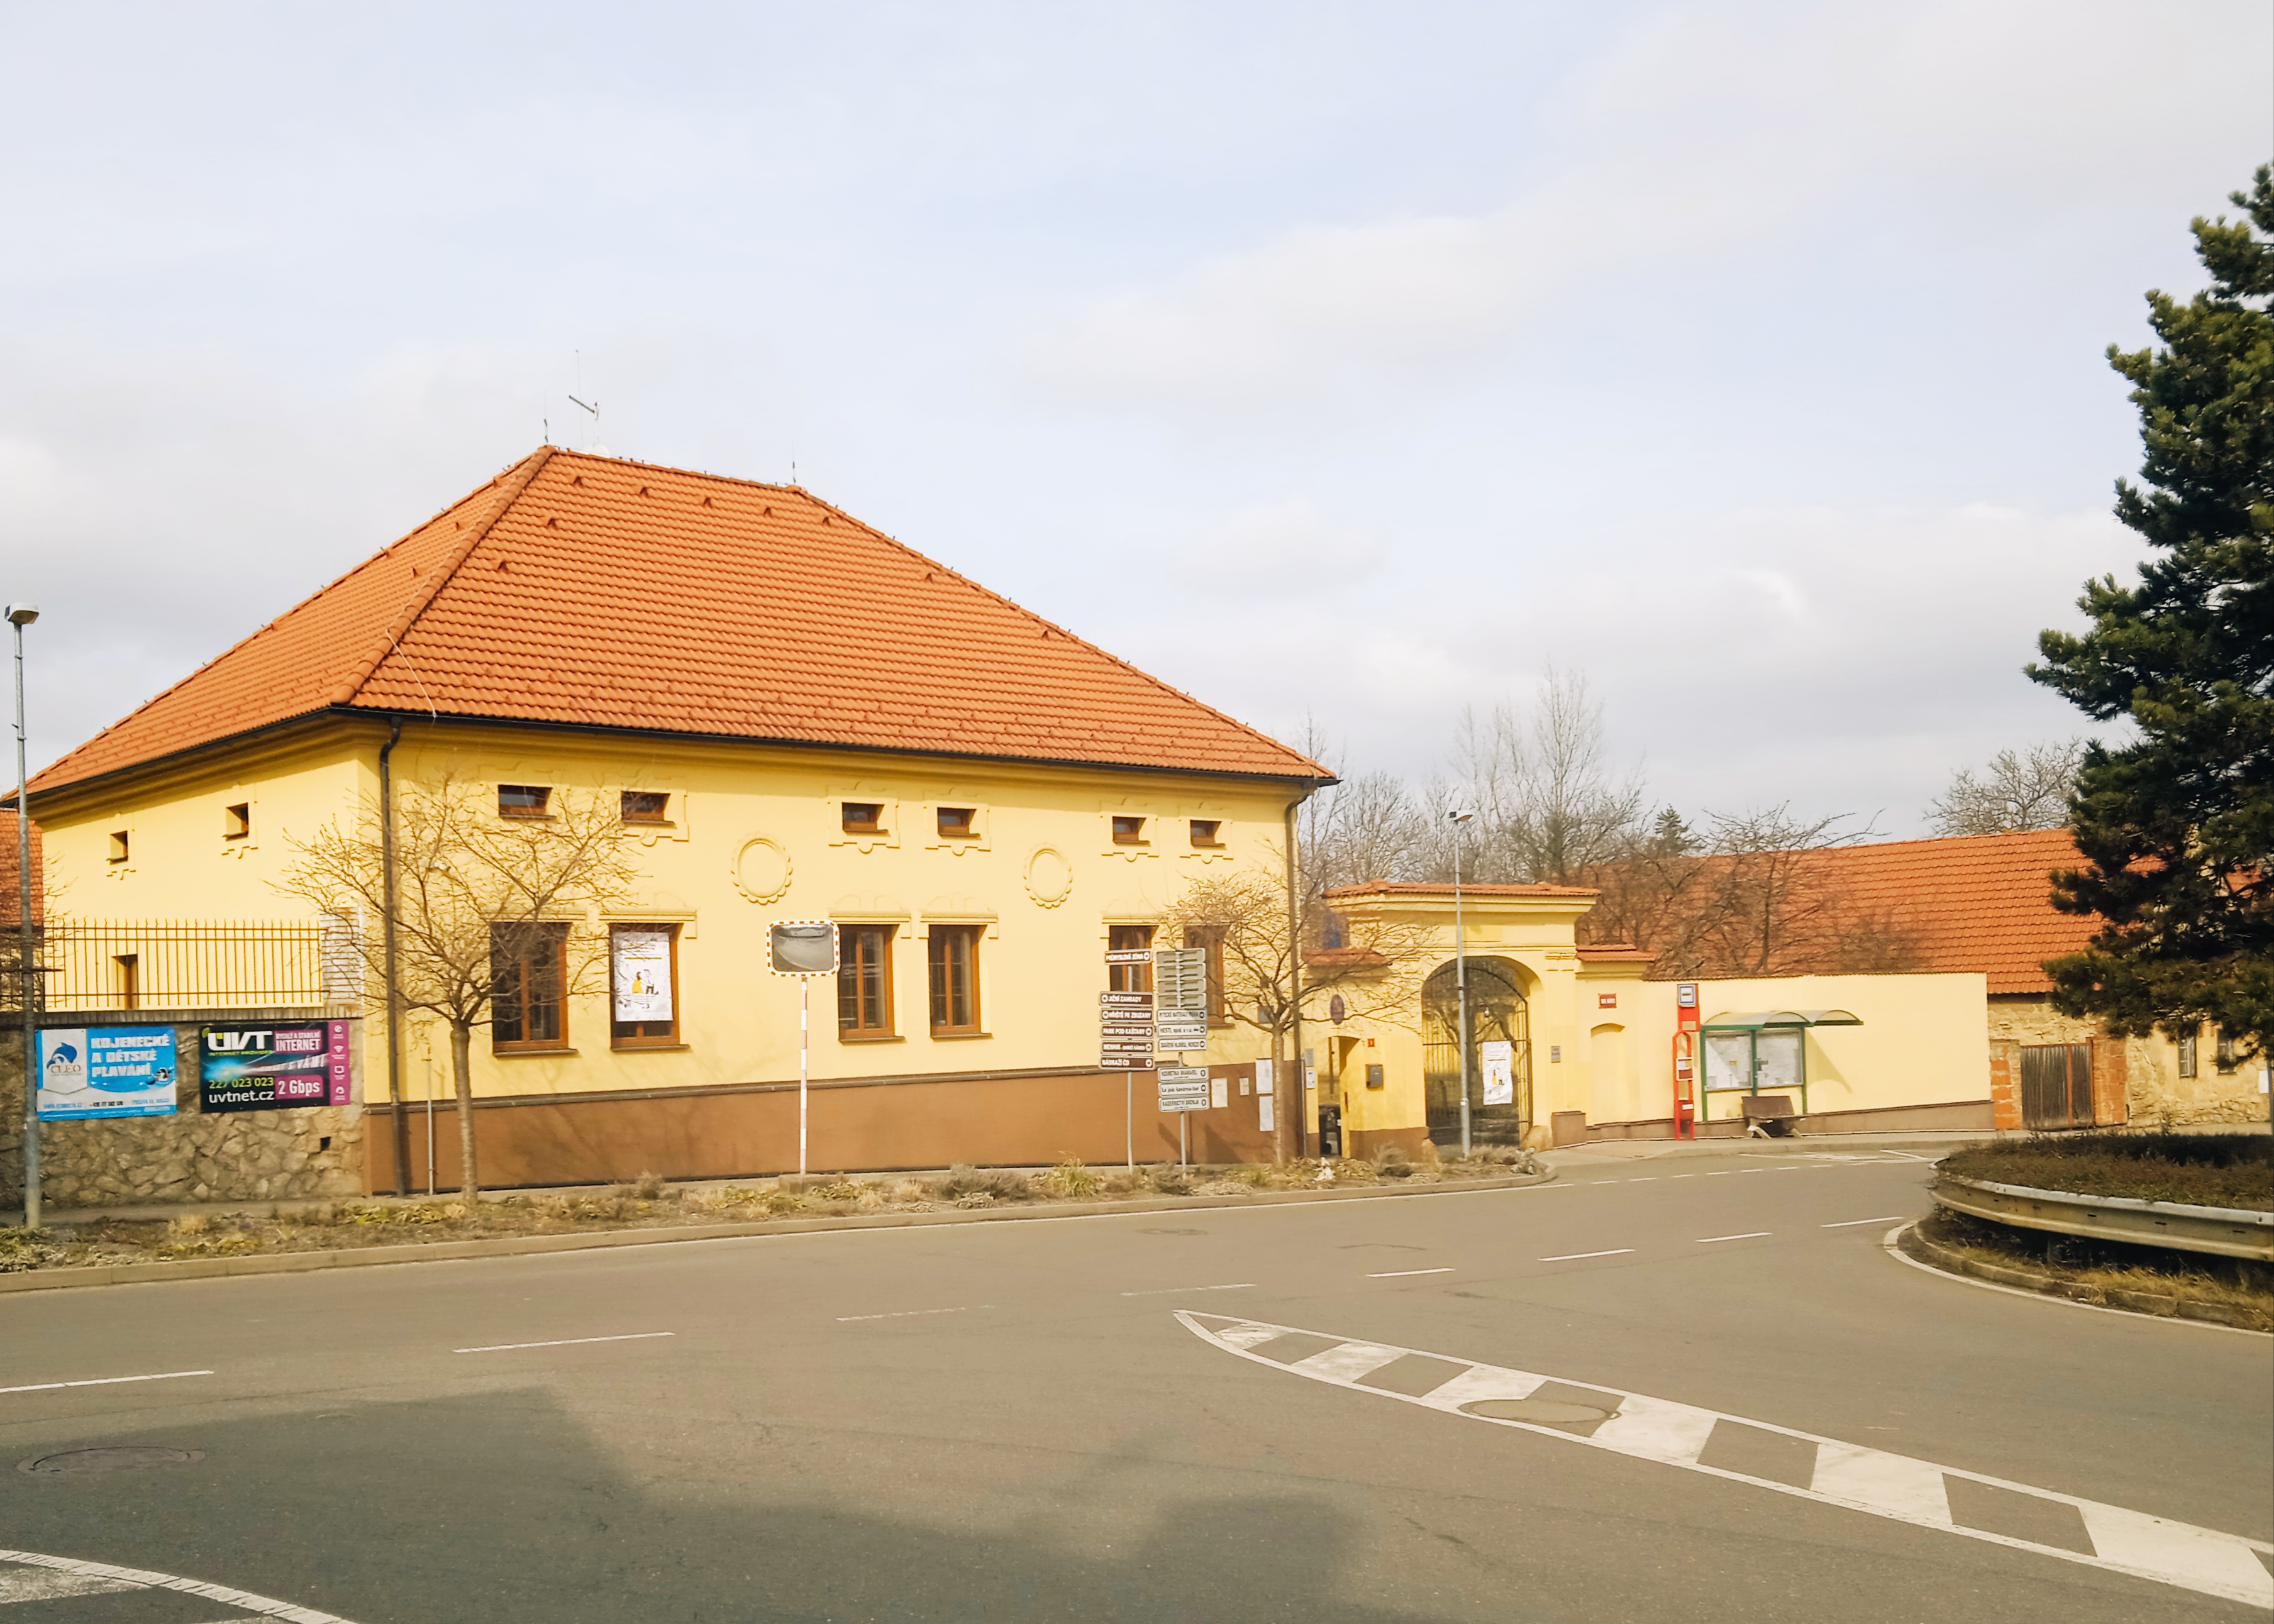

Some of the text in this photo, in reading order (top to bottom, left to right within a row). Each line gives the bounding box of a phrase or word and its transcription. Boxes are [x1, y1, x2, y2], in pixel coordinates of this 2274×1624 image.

[1125, 1027, 1145, 1035] KAŠTANY
[91, 1034, 170, 1049] KOJENECKÉ
[208, 1031, 273, 1051] UVT
[276, 1039, 321, 1051] INTERNET
[91, 1048, 157, 1063] A DĚTSKÉ
[50, 1064, 81, 1073] CLEO
[92, 1063, 151, 1077] PLAVÁNÍ
[209, 1077, 274, 1089] 227 023 023
[278, 1080, 321, 1096] 2 Gbps
[209, 1090, 274, 1103] uvtnet.cz
